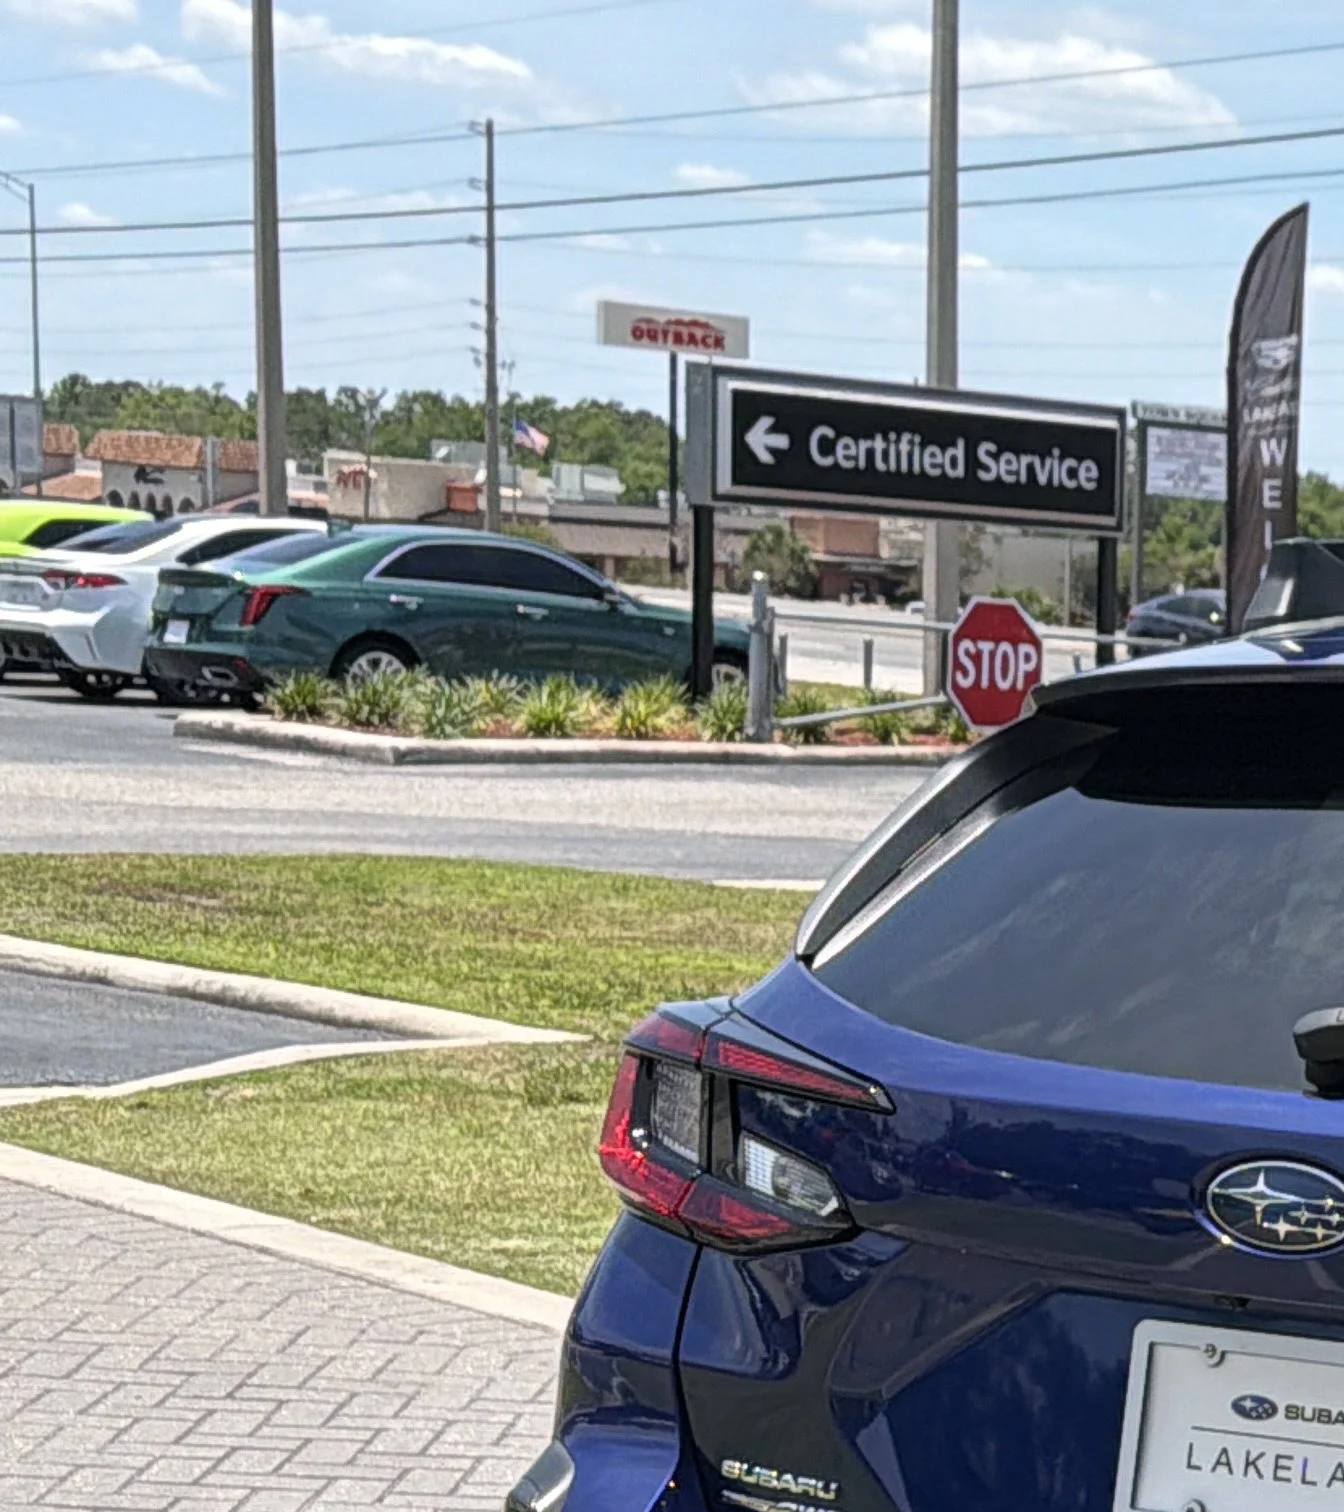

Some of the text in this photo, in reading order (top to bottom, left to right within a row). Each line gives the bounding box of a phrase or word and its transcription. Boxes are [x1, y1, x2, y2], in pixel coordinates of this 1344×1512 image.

[631, 324, 726, 351] OUTBACK
[809, 425, 966, 479] Certified
[976, 440, 1099, 491] Service
[956, 638, 1039, 691] STOP
[720, 1459, 840, 1500] SUBARU
